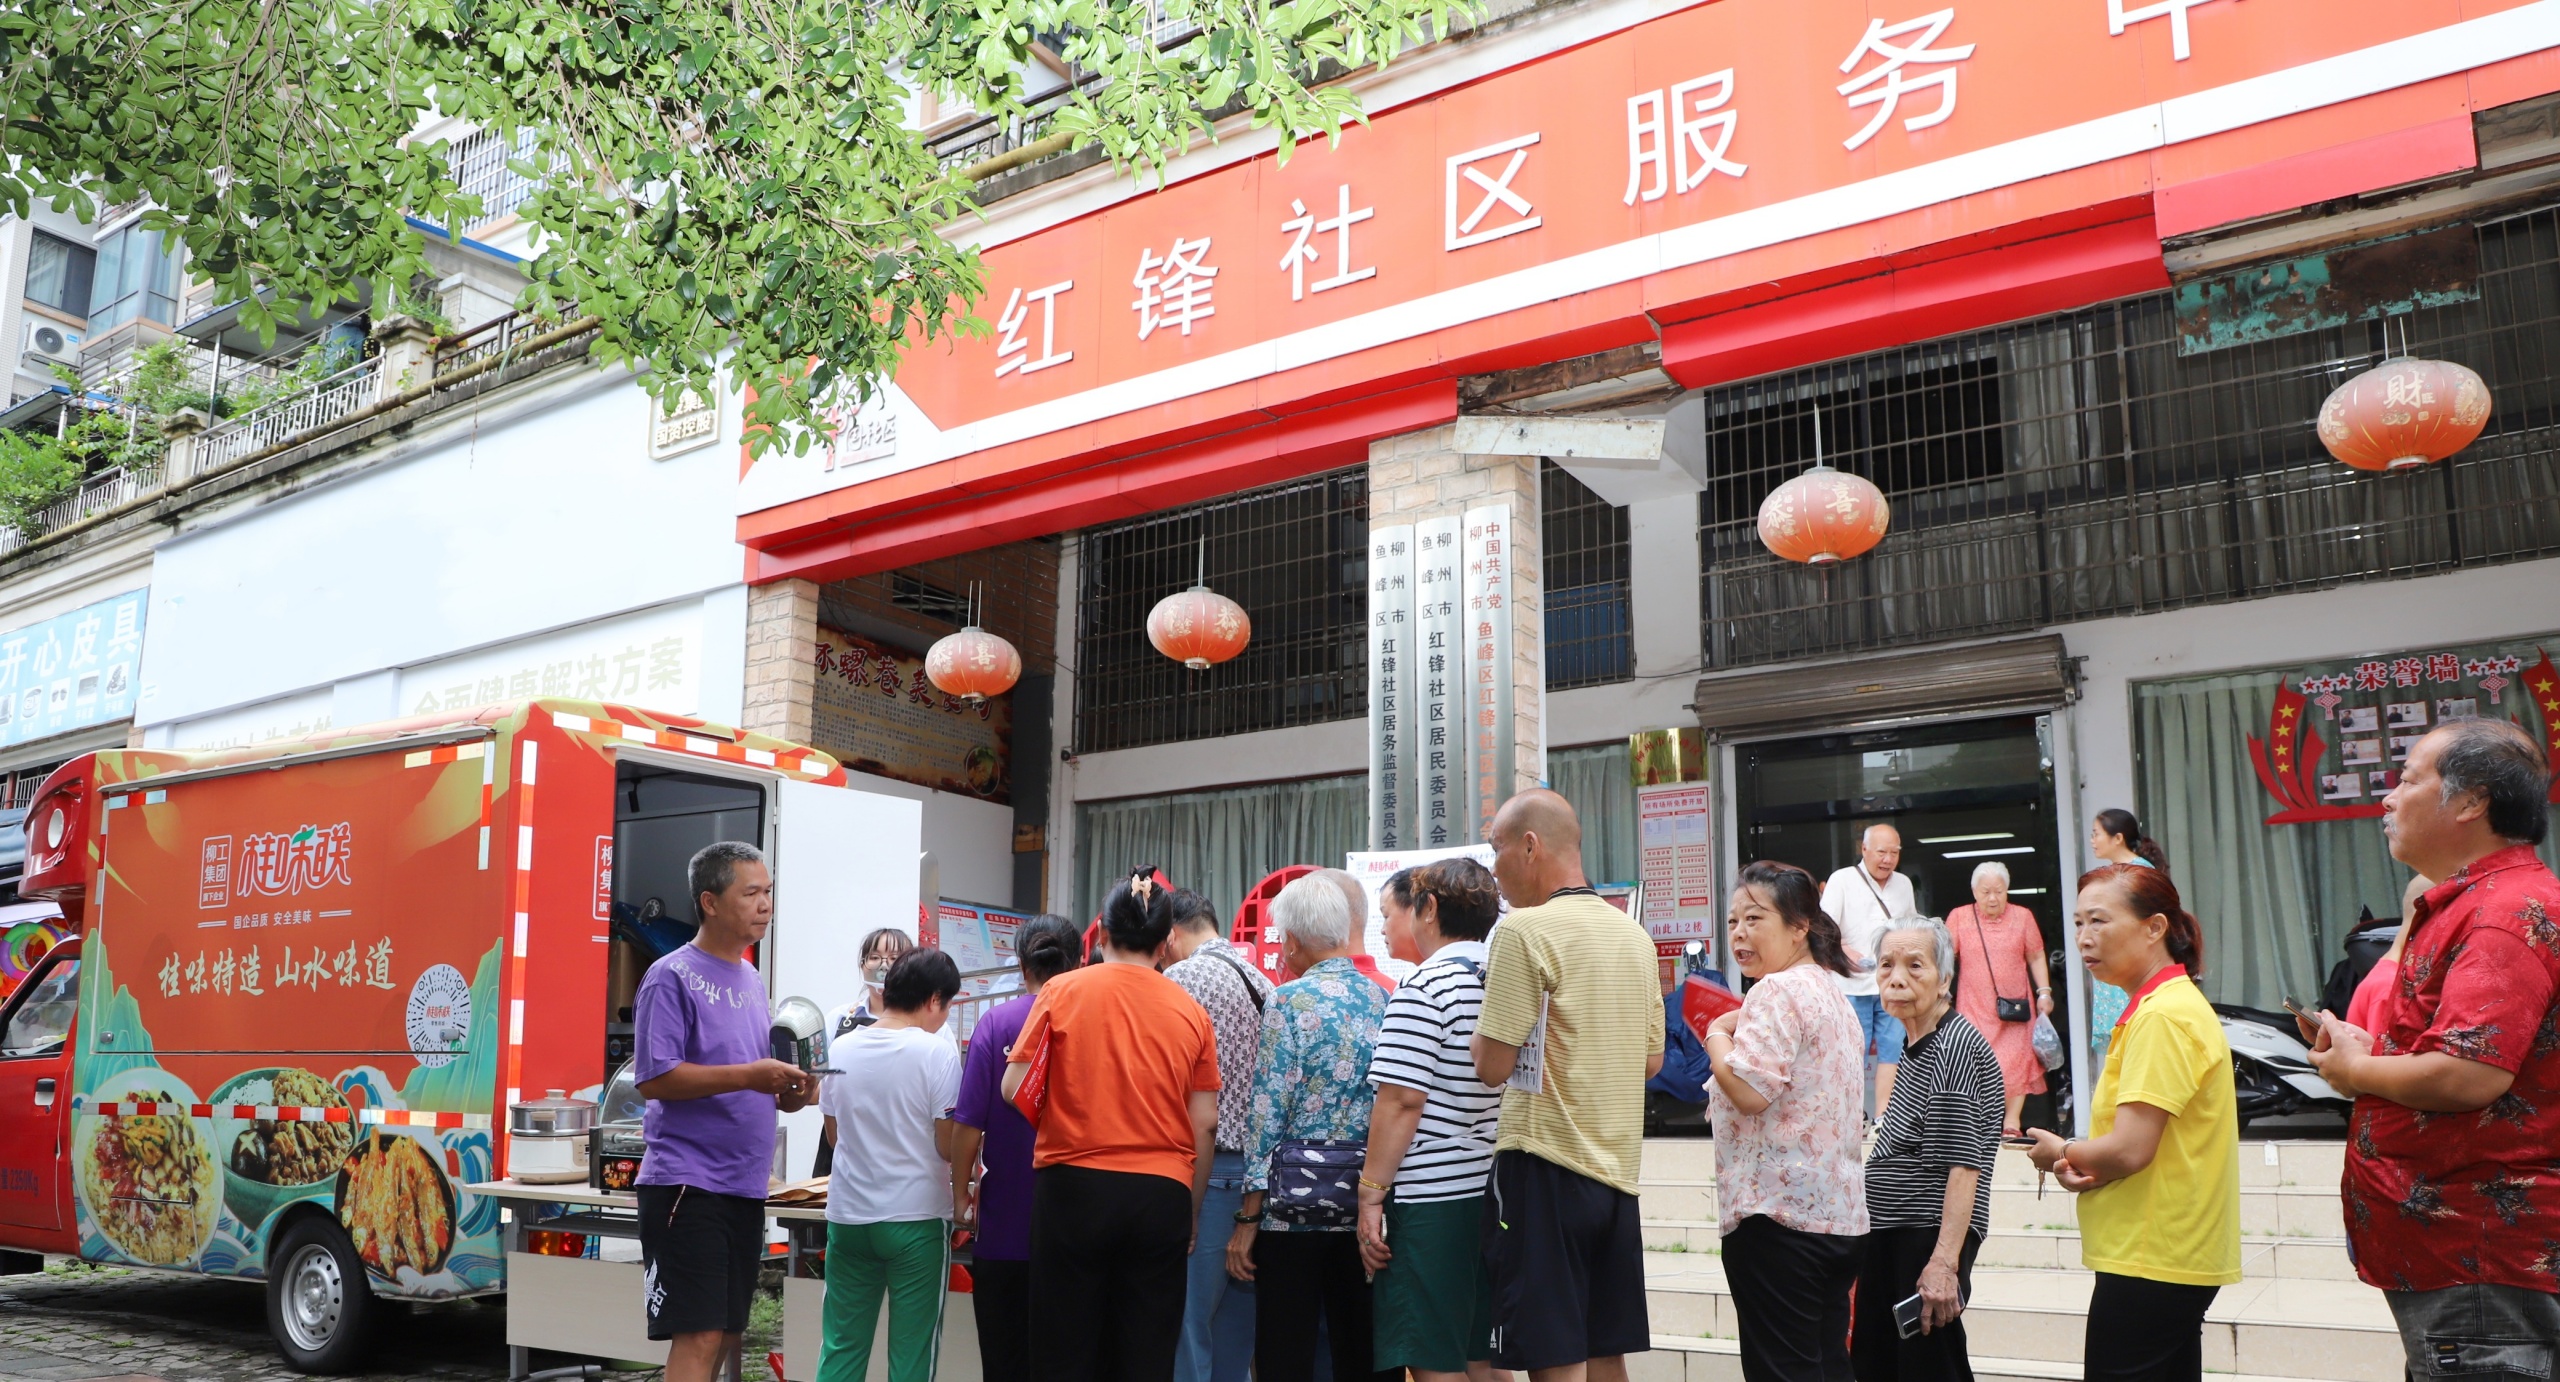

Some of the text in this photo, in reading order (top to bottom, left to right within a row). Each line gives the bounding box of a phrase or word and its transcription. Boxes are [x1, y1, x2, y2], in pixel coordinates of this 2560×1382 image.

[1375, 544, 1388, 627] 鱼峰区
[1390, 541, 1406, 624] 柳州市
[1421, 535, 1434, 620] 鱼峰区
[1436, 532, 1452, 617] 柳州市
[1469, 525, 1483, 611] 柳州市
[1485, 521, 1502, 610] 中国共产党
[0, 599, 141, 690] 开心皮具
[2354, 653, 2460, 692] 荣誉墙
[1381, 638, 1397, 849] 红锋社区居务监督委员会
[1428, 631, 1447, 844] 红锋社区居民委员会
[1477, 621, 1498, 841] 鱼峰区红锋社区委员会
[204, 864, 227, 884] 集团
[206, 843, 229, 863] 柳工
[236, 821, 352, 898] 桂味联
[202, 892, 224, 903] 旗下企业
[233, 910, 313, 930] 国企品质 安全美味
[157, 935, 397, 1000] 桂味特造 山水味道
